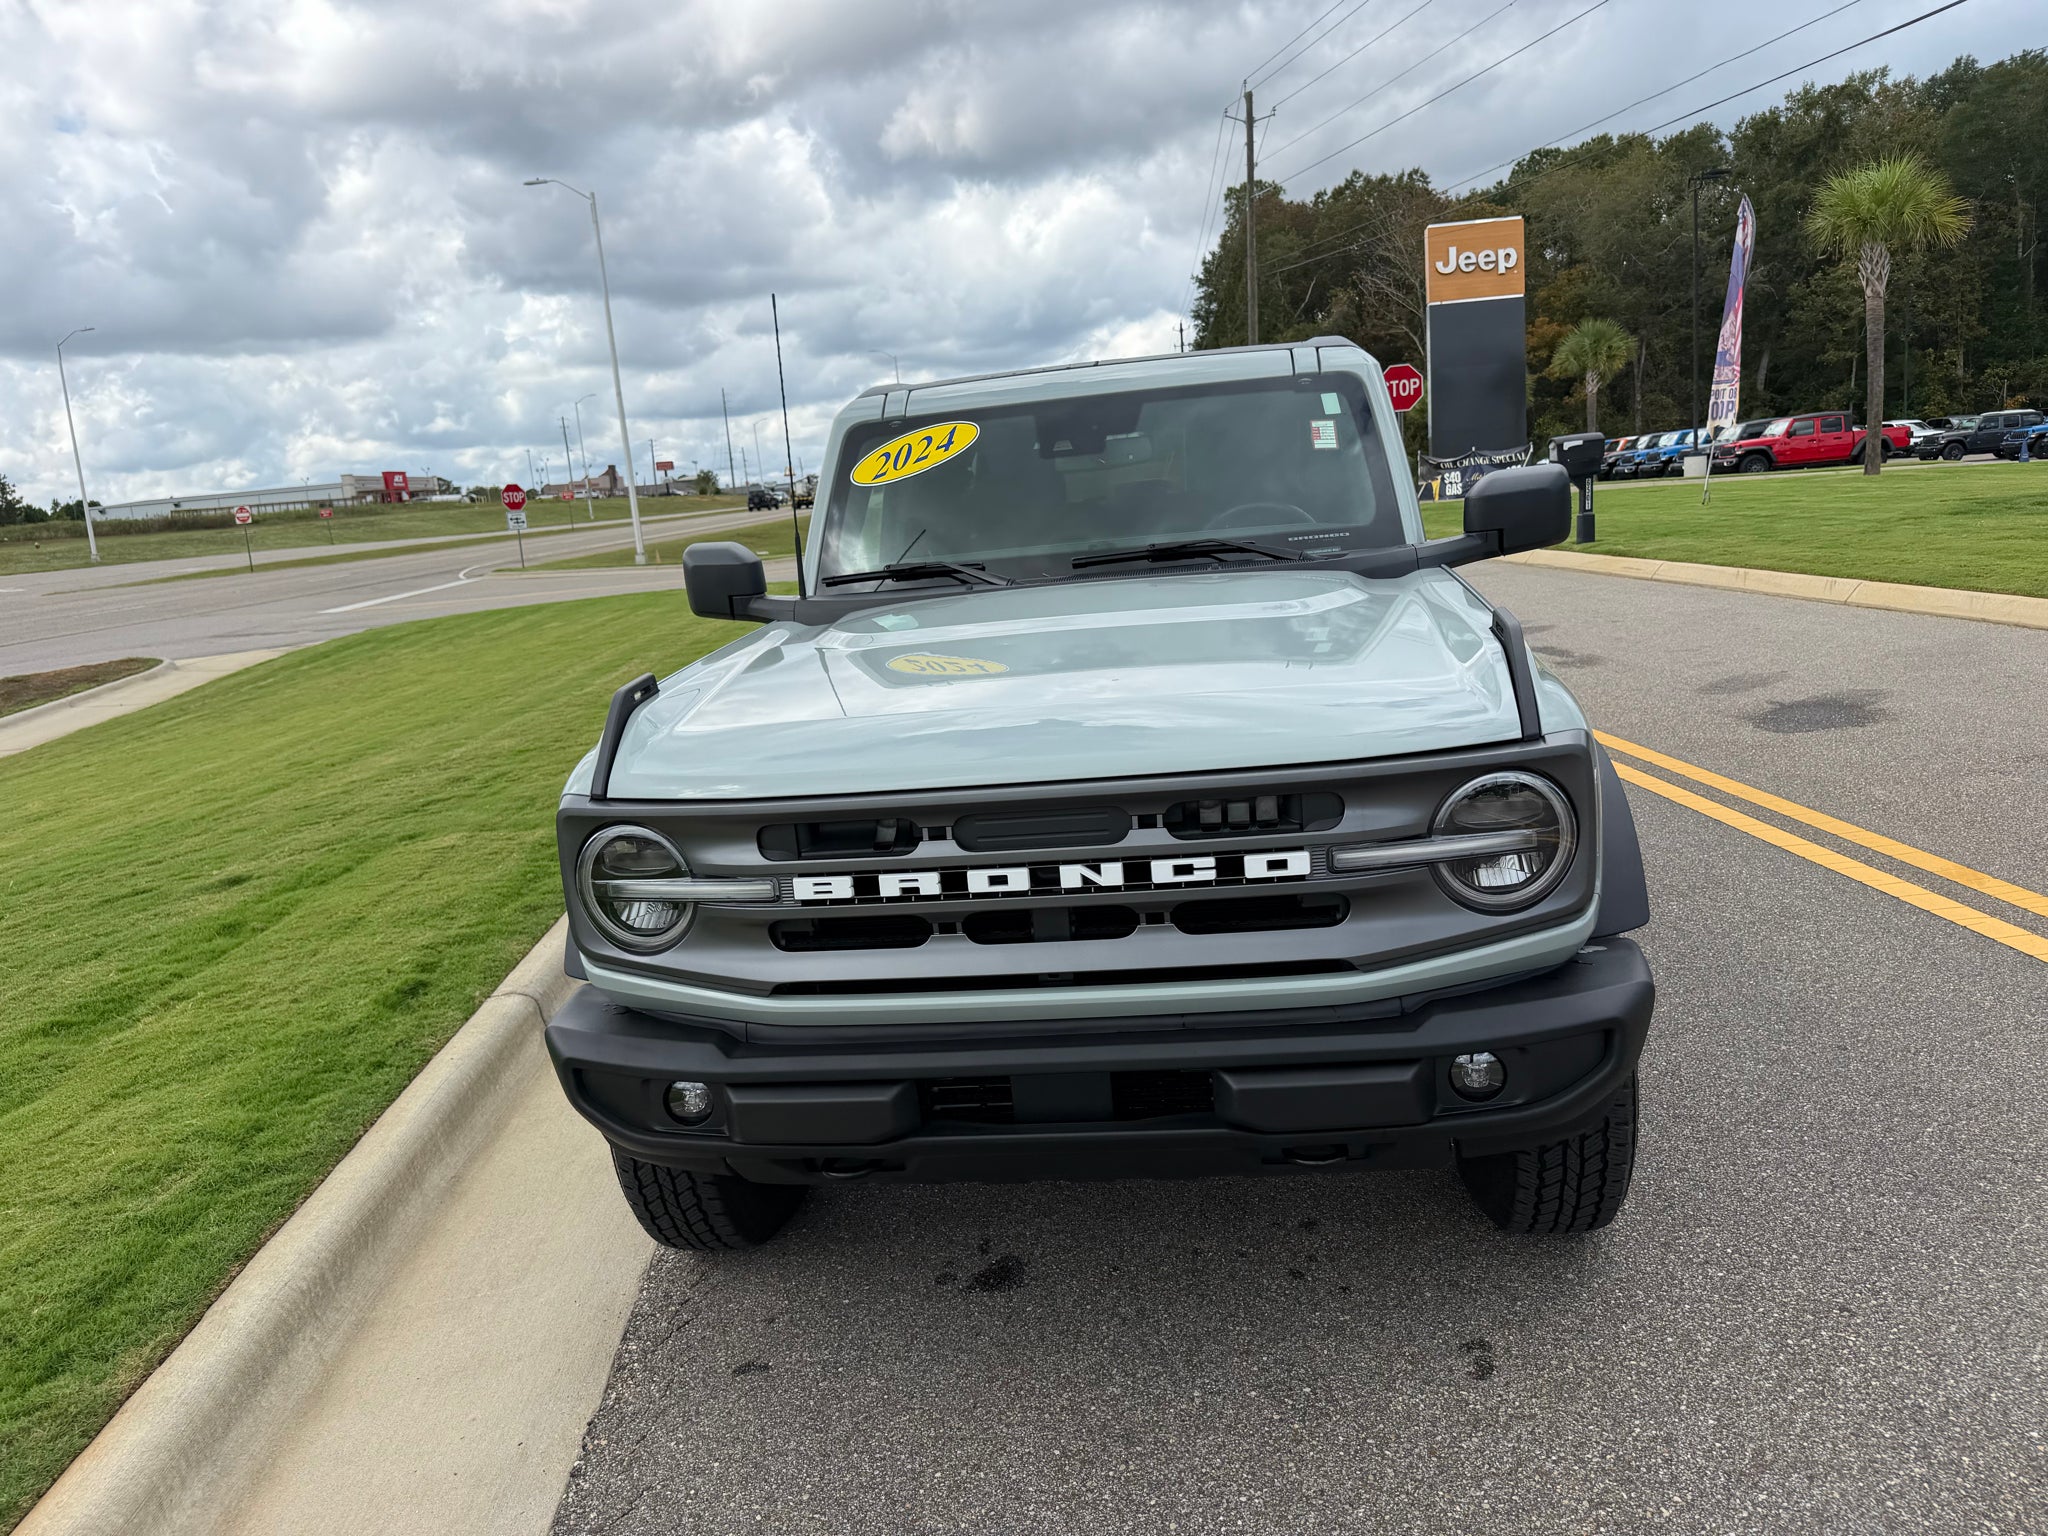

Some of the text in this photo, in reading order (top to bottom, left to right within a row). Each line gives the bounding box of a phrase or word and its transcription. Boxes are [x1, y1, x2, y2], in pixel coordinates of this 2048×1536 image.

[1435, 246, 1518, 275] Jeep
[1385, 378, 1420, 397] TOP
[871, 425, 958, 481] 2024
[1457, 456, 1490, 468] CHANGE
[1491, 452, 1526, 465] SPECIAL
[503, 491, 525, 503] STOP
[1446, 483, 1462, 496] GAS
[792, 850, 1311, 900] BRONCO
